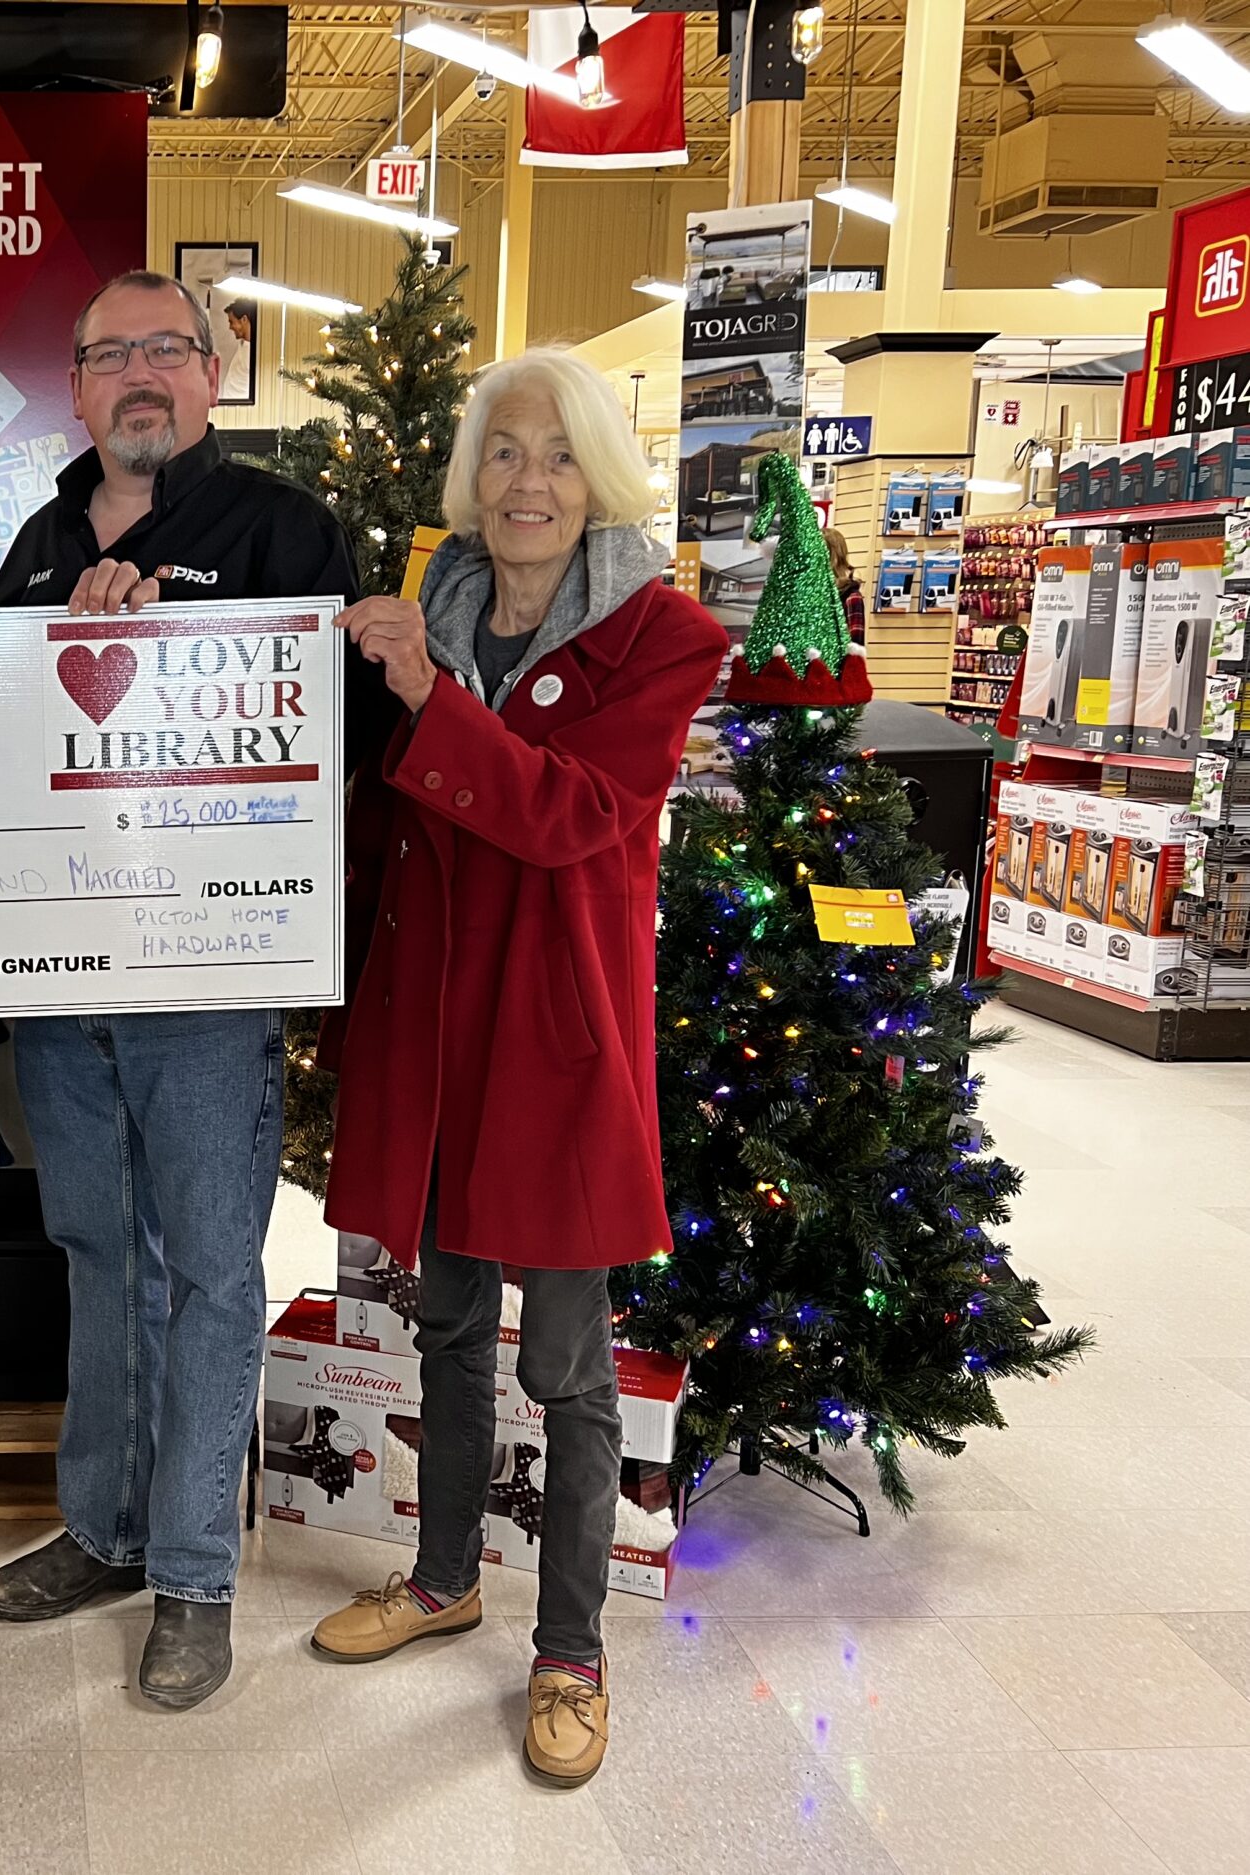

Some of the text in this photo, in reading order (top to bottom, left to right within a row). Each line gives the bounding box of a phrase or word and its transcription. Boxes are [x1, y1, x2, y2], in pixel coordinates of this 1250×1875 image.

[377, 163, 418, 195] EXIT
[1174, 368, 1188, 432] FROM
[170, 564, 219, 584] PRO
[1126, 604, 1144, 612] Oil-
[1128, 594, 1144, 602] 150
[155, 634, 302, 679] LOVE
[153, 680, 308, 723] YOUR
[62, 724, 304, 771] LIBRARY
[67, 851, 176, 896] MATCHED
[231, 907, 290, 925] HOME
[143, 932, 275, 958] HARDWARE
[498, 1332, 520, 1341] ATE
[315, 1362, 403, 1394] Sunbeam
[297, 1381, 344, 1395] MICROPLUSH
[346, 1389, 390, 1403] REVERSIBLE
[329, 1394, 388, 1409] HEATED THROW
[612, 1549, 652, 1563] HEATED
